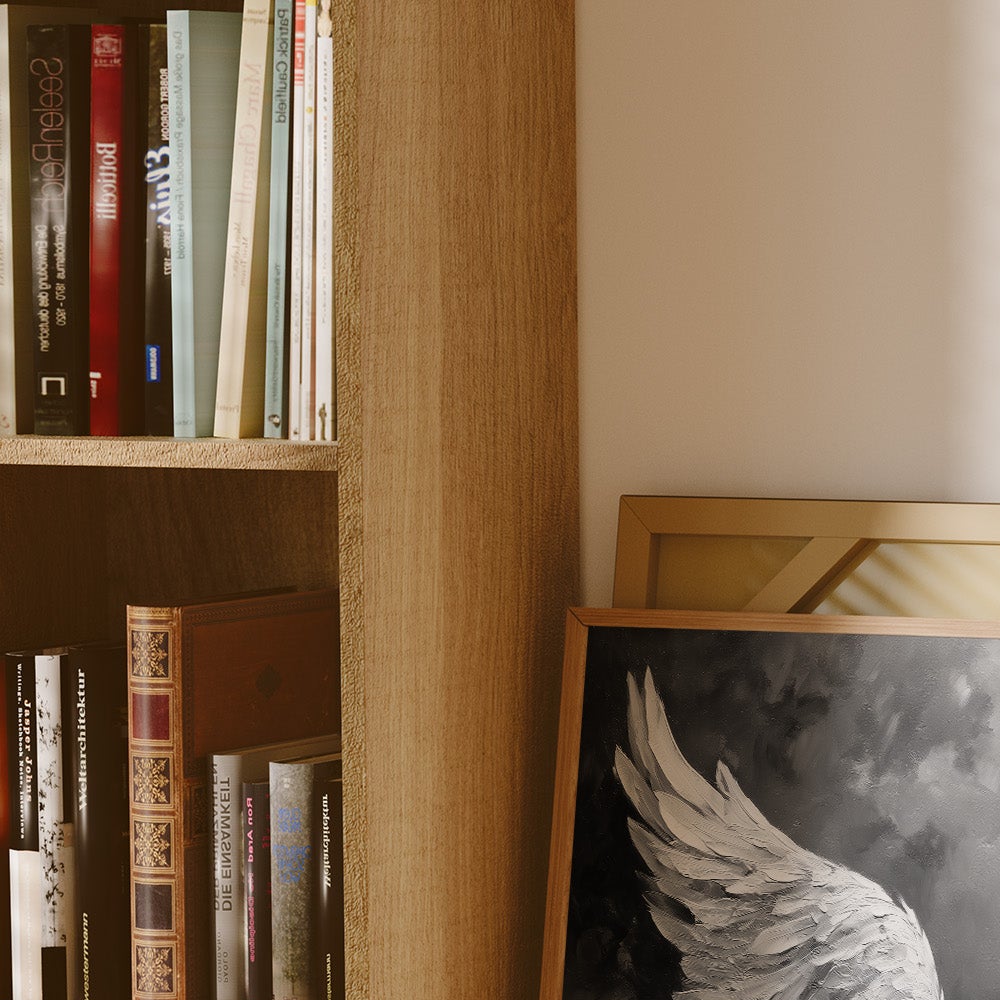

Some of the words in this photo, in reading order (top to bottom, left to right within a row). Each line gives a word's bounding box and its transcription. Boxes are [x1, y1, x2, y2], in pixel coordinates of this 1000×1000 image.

[23, 700, 31, 751] Jasper
[76, 668, 87, 810] Weltarchitektur
[24, 757, 32, 804] Johns
